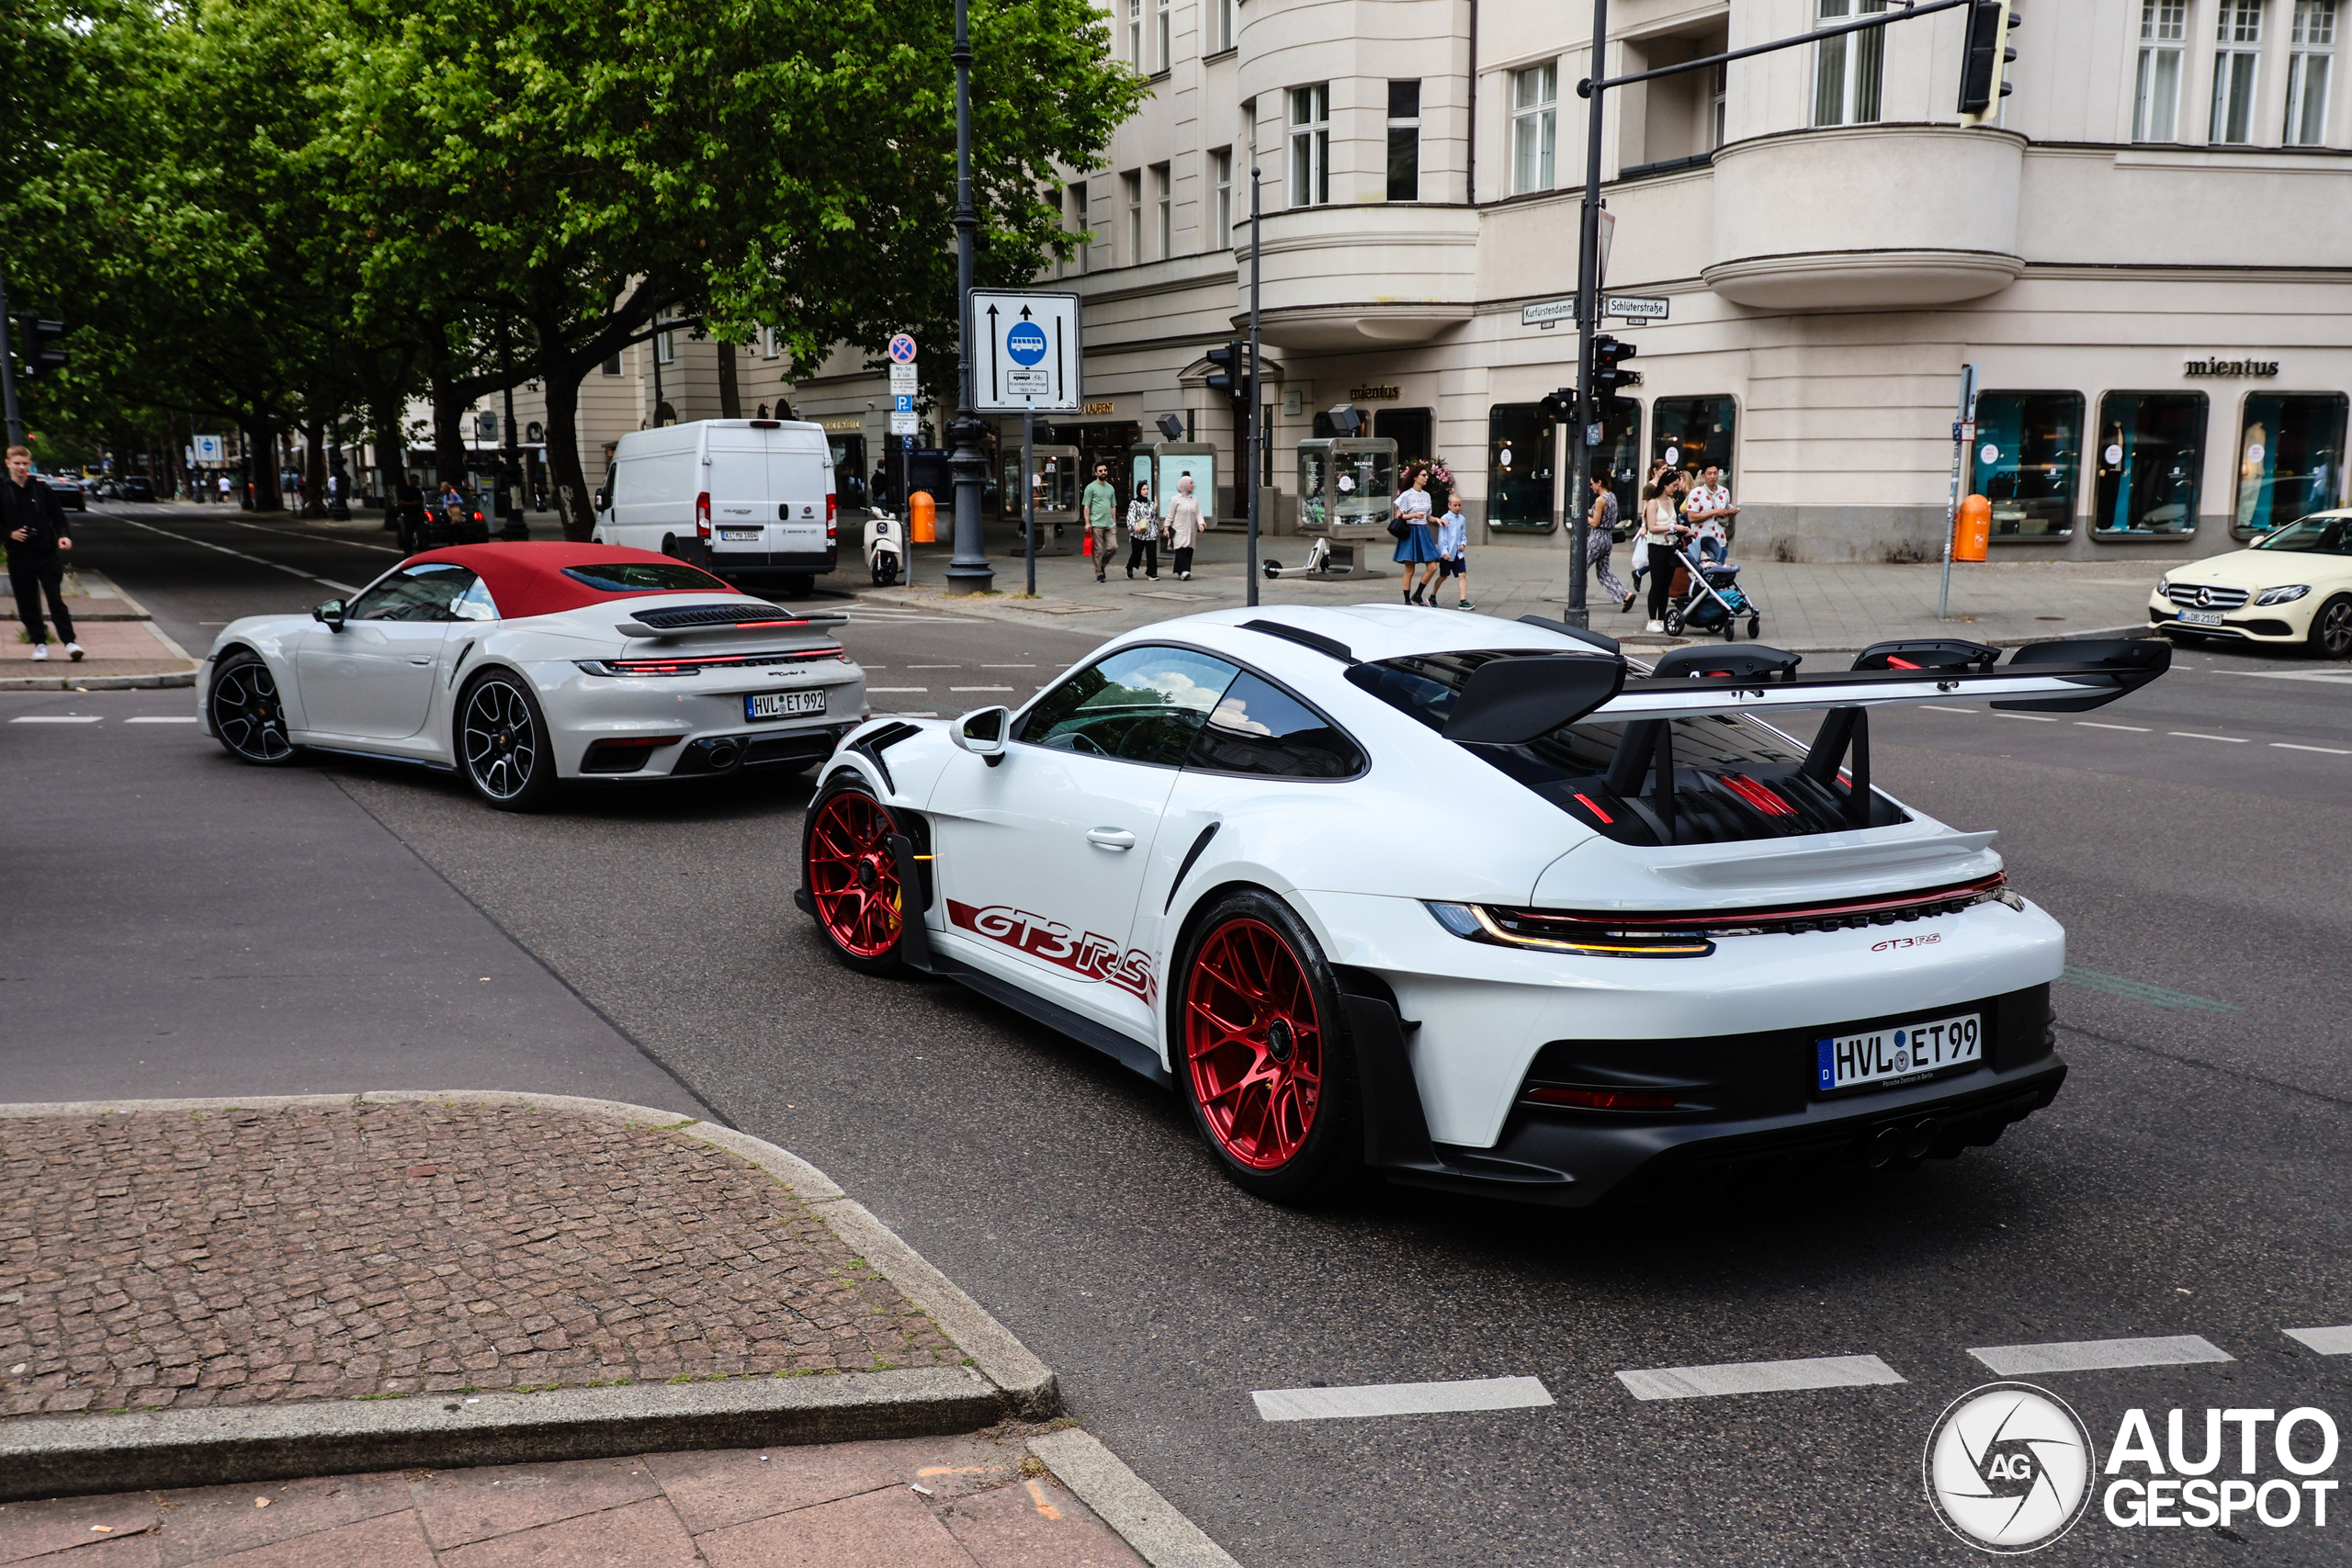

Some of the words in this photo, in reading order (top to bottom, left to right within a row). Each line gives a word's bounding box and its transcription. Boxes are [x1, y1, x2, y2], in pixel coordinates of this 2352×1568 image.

[1525, 303, 1573, 319] Kurfürstendamm
[1611, 299, 1664, 315] Schlüterstraße
[2184, 355, 2279, 376] mientus
[1350, 384, 1400, 400] mientus
[899, 396, 908, 410] P
[1086, 402, 1114, 414] LAURENT
[2200, 614, 2221, 624] 2101
[754, 696, 778, 715] HVL
[786, 694, 801, 711] ET
[804, 692, 824, 710] 992
[1785, 901, 1964, 935] PORSCHE
[1822, 1068, 1830, 1080] D
[1836, 1035, 1894, 1080] HVL
[1911, 1025, 1945, 1067] ET
[1949, 1019, 1977, 1059] 99
[1883, 1078, 1900, 1088] Porsche
[1900, 1076, 1917, 1084] Zentren
[1921, 1072, 1934, 1081] Berlin
